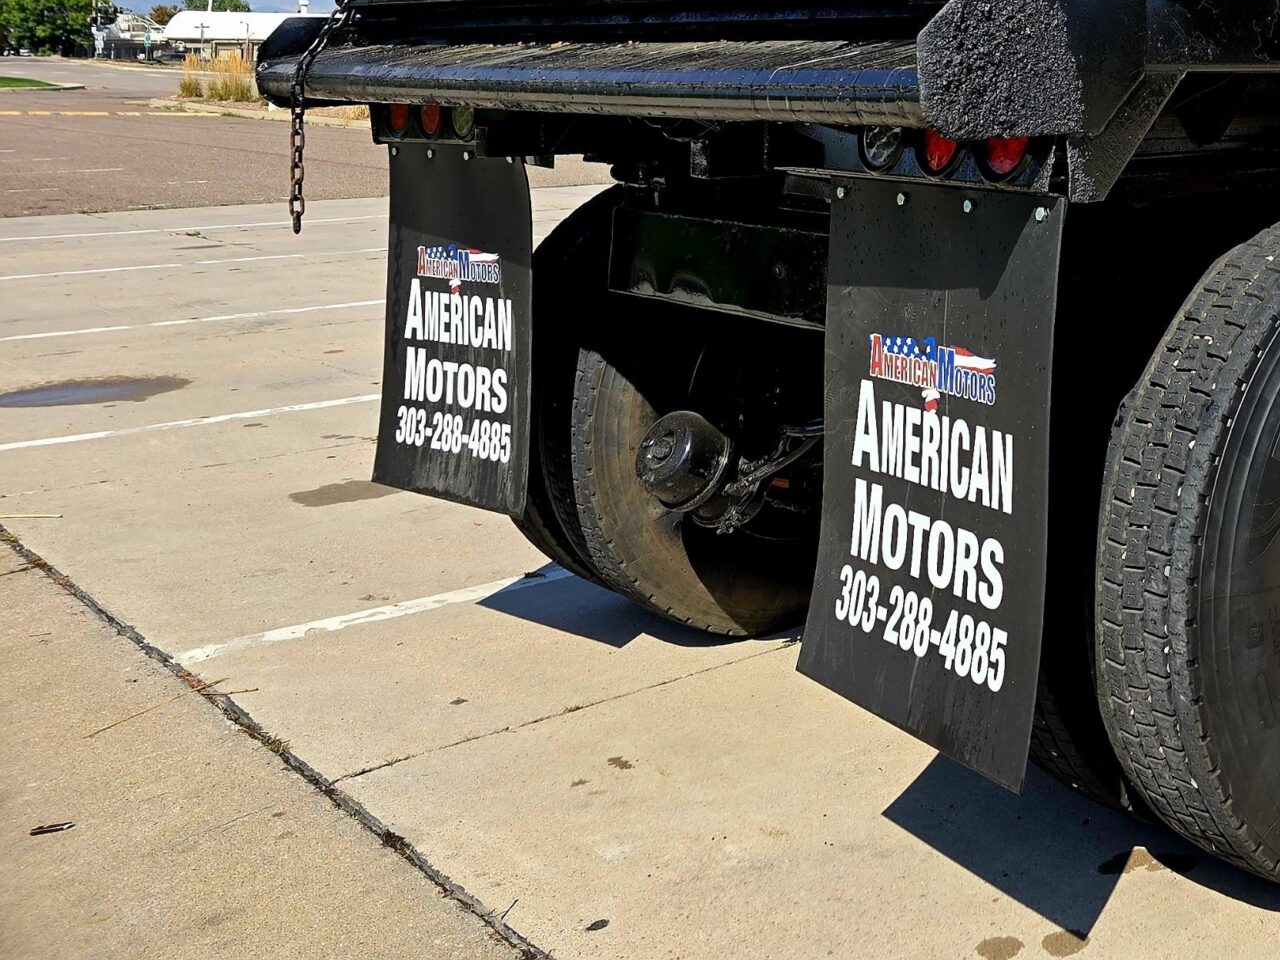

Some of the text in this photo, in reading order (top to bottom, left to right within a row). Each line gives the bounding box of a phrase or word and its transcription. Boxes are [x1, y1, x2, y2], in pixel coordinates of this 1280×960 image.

[417, 246, 500, 284] AMERICAN MOTORS
[404, 278, 512, 352] AMERICAN
[403, 346, 508, 414] MOTORS
[869, 333, 996, 406] AMERICAN MOTORS
[395, 405, 512, 464] 303-288-4885
[851, 378, 1013, 515] AMERICAN
[850, 477, 1005, 610] MOTORS
[834, 564, 1008, 692] 303-288-4885
